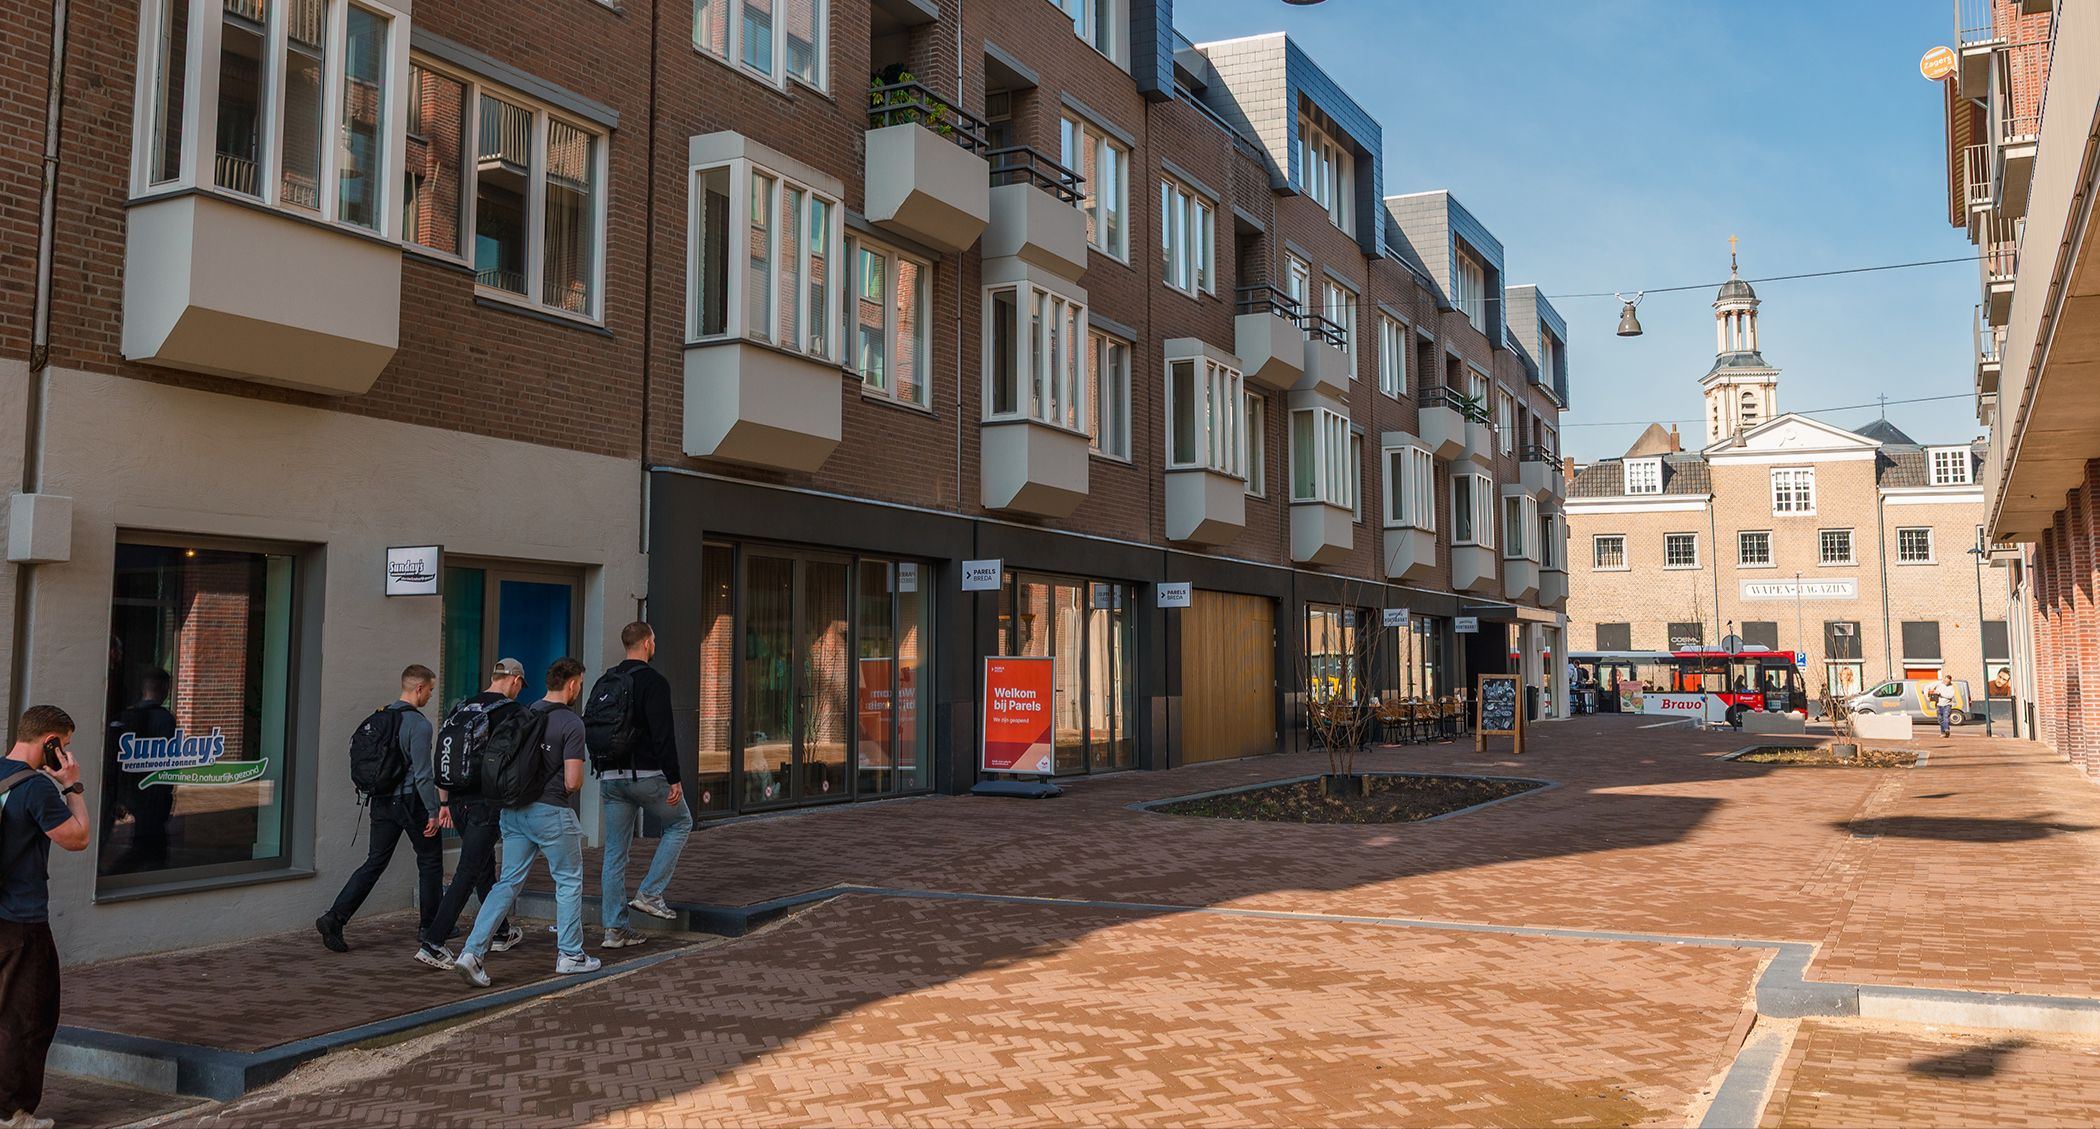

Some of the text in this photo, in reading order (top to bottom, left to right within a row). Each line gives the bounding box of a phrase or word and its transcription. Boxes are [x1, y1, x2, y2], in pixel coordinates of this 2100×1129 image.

[389, 559, 425, 575] Sunday's
[994, 688, 1036, 698] Welkom
[994, 700, 1041, 712] bij Parels
[1661, 699, 1702, 709] Bravo
[119, 728, 224, 763] Sunday's
[124, 759, 197, 769] verantwoord zonnen
[440, 737, 452, 781] OAKLEY
[158, 771, 191, 781] vitamine
[199, 773, 234, 784] natuurlijk
[234, 766, 260, 781] gezond
